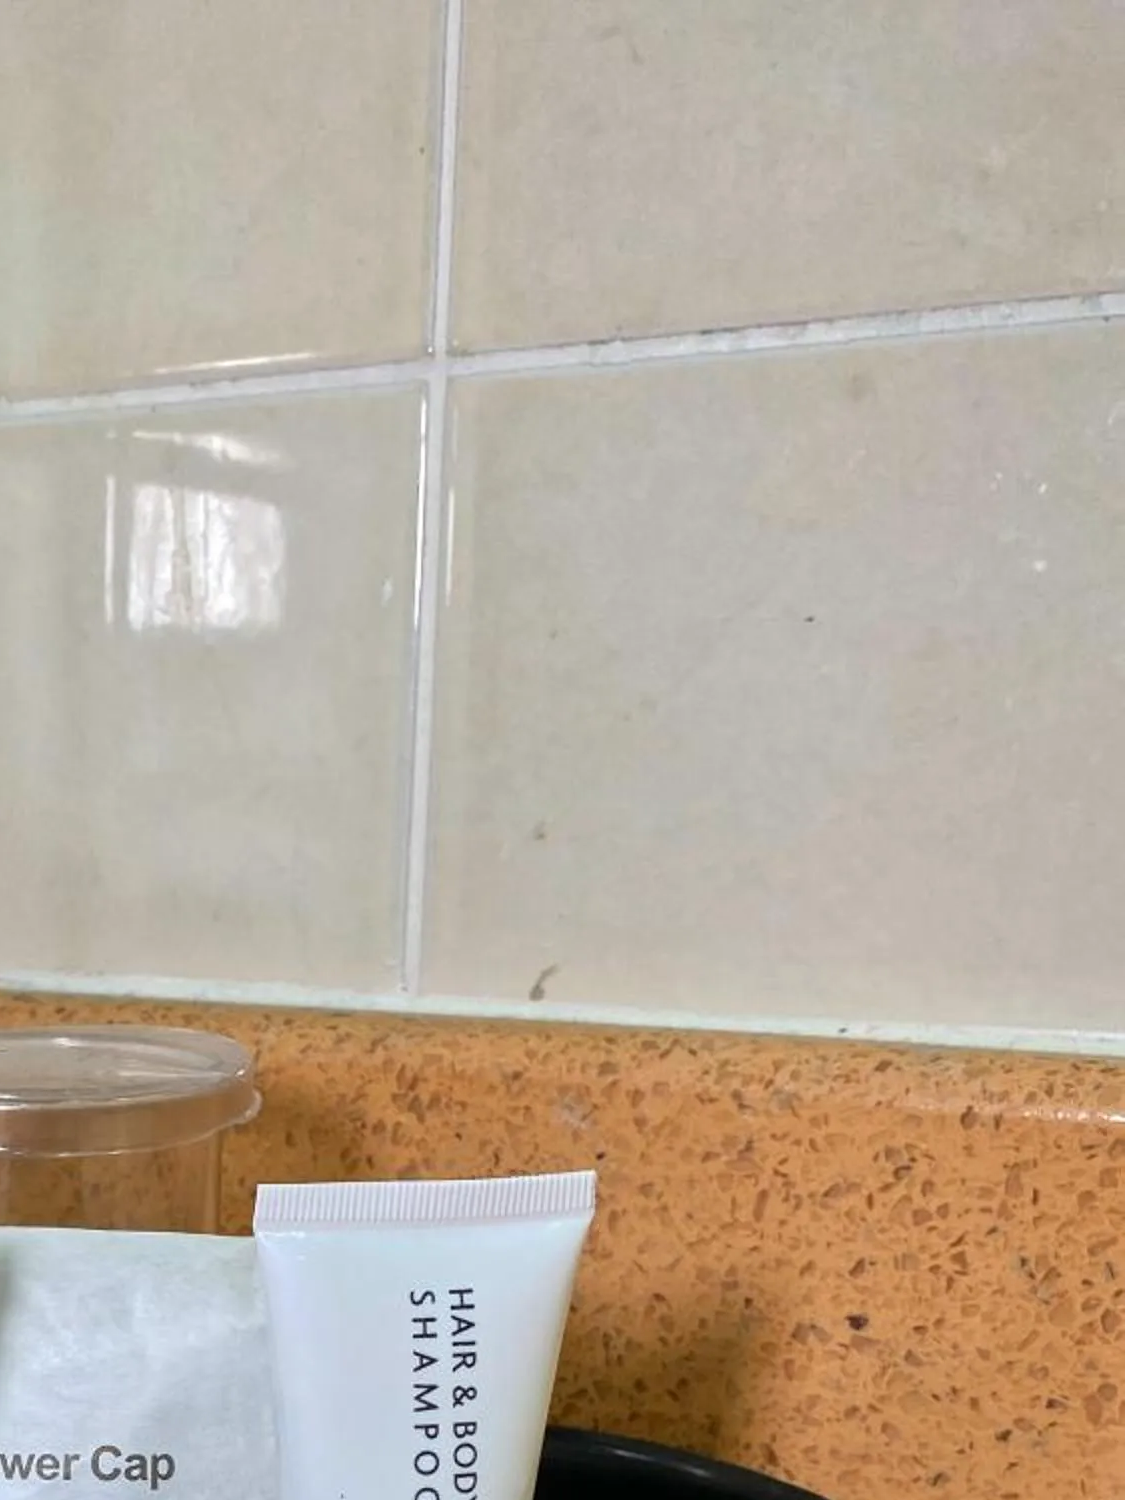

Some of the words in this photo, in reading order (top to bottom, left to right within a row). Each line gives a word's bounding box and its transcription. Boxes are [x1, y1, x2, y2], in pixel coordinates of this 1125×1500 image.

[448, 1287, 478, 1373] HAIR
[451, 1384, 478, 1409] &
[90, 1445, 176, 1491] Cap
